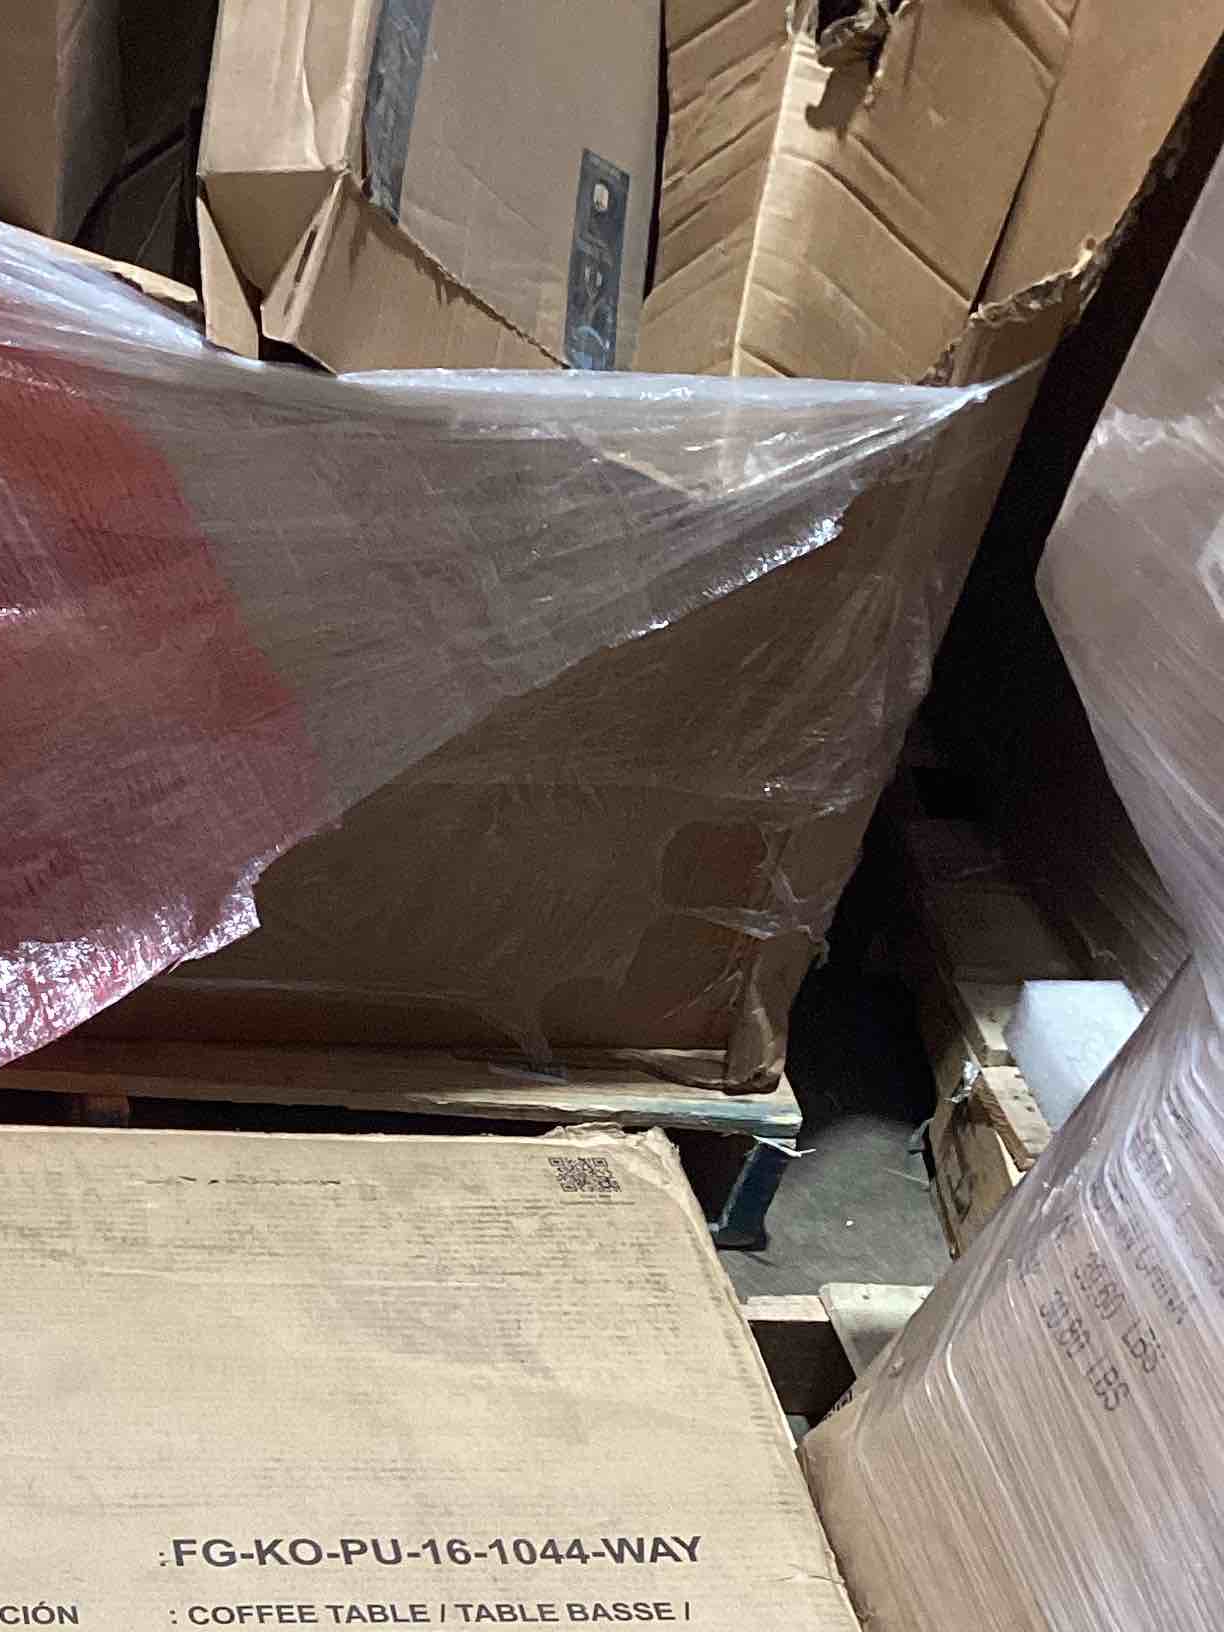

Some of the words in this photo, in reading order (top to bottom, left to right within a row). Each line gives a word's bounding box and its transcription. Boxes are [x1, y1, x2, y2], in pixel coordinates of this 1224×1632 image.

[188, 1604, 319, 1626] COFFEE
[324, 1603, 431, 1624] TABLE
[453, 1603, 560, 1623] TABLE
[565, 1602, 677, 1622] BASSE
